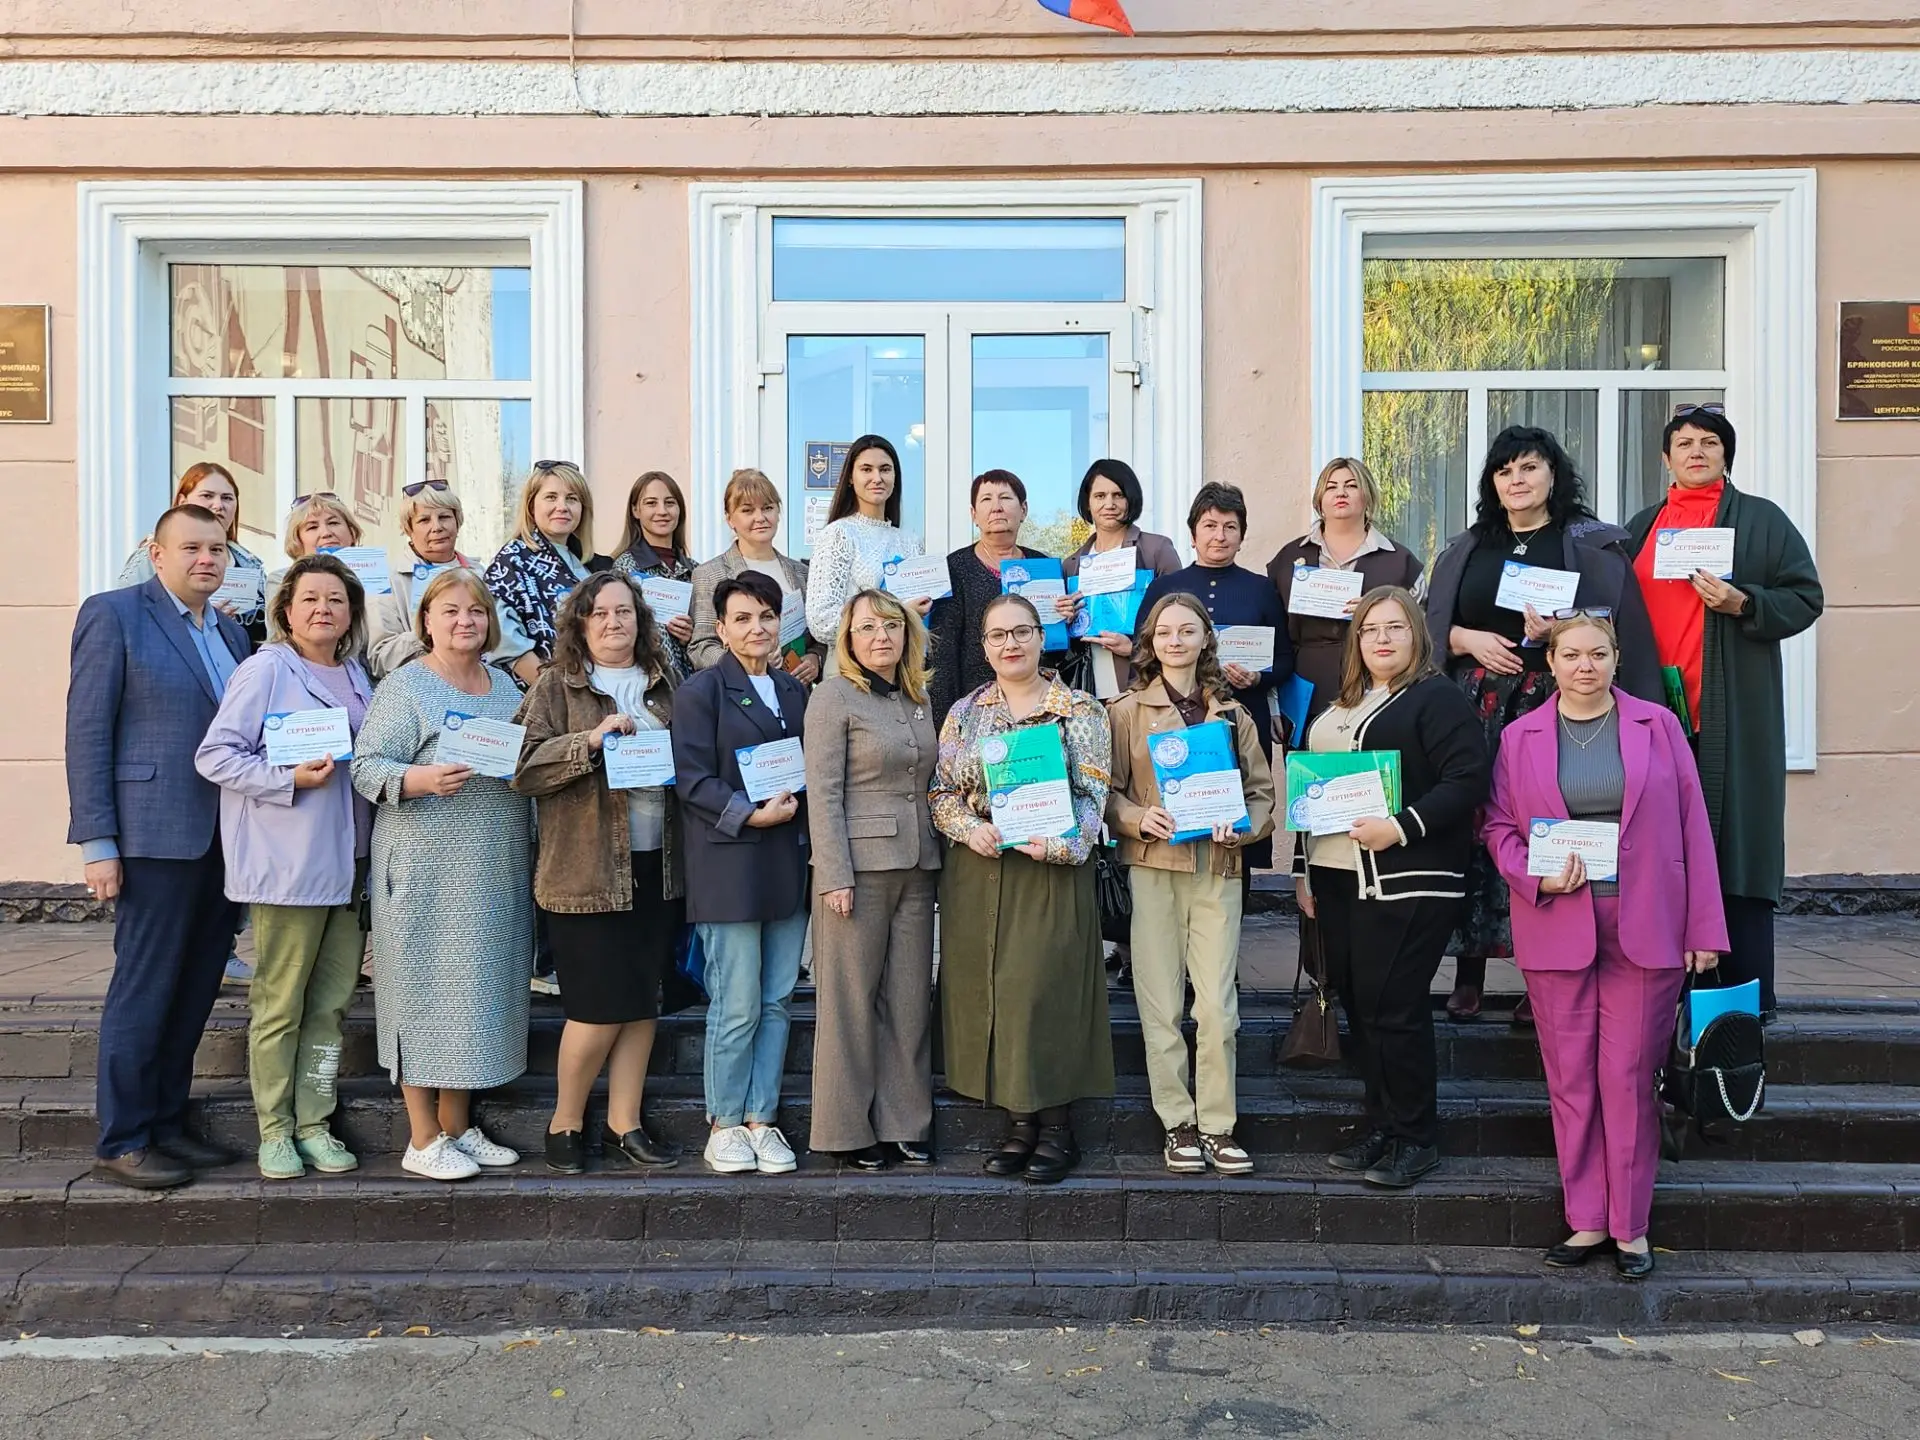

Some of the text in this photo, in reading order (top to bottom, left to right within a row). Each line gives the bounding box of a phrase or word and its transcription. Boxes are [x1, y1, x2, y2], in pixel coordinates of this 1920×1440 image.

[1847, 360, 1909, 368] БРЯНКОВСКИЙ
[900, 568, 937, 578] СЕРТИФИКАТ
[1309, 583, 1350, 592] СЕРТИФИКАТ
[1520, 579, 1565, 591] СЕРТИФИКАТ
[1221, 639, 1262, 647] СЕРТИФИКАТ
[286, 725, 335, 735] СЕРТИФИКАТ
[463, 732, 509, 747] СЕРТИФИКАТ
[621, 747, 661, 757] СЕРТИФИКАТ
[755, 755, 793, 769] СЕРТИФИКАТ
[1184, 788, 1231, 799] СЕРТИФИКАТ
[1327, 789, 1372, 802] СЕРТИФИКАТ
[1011, 799, 1057, 811] СЕРТИФИКАТ
[1551, 838, 1604, 847] СЕРТИФИКАТ
